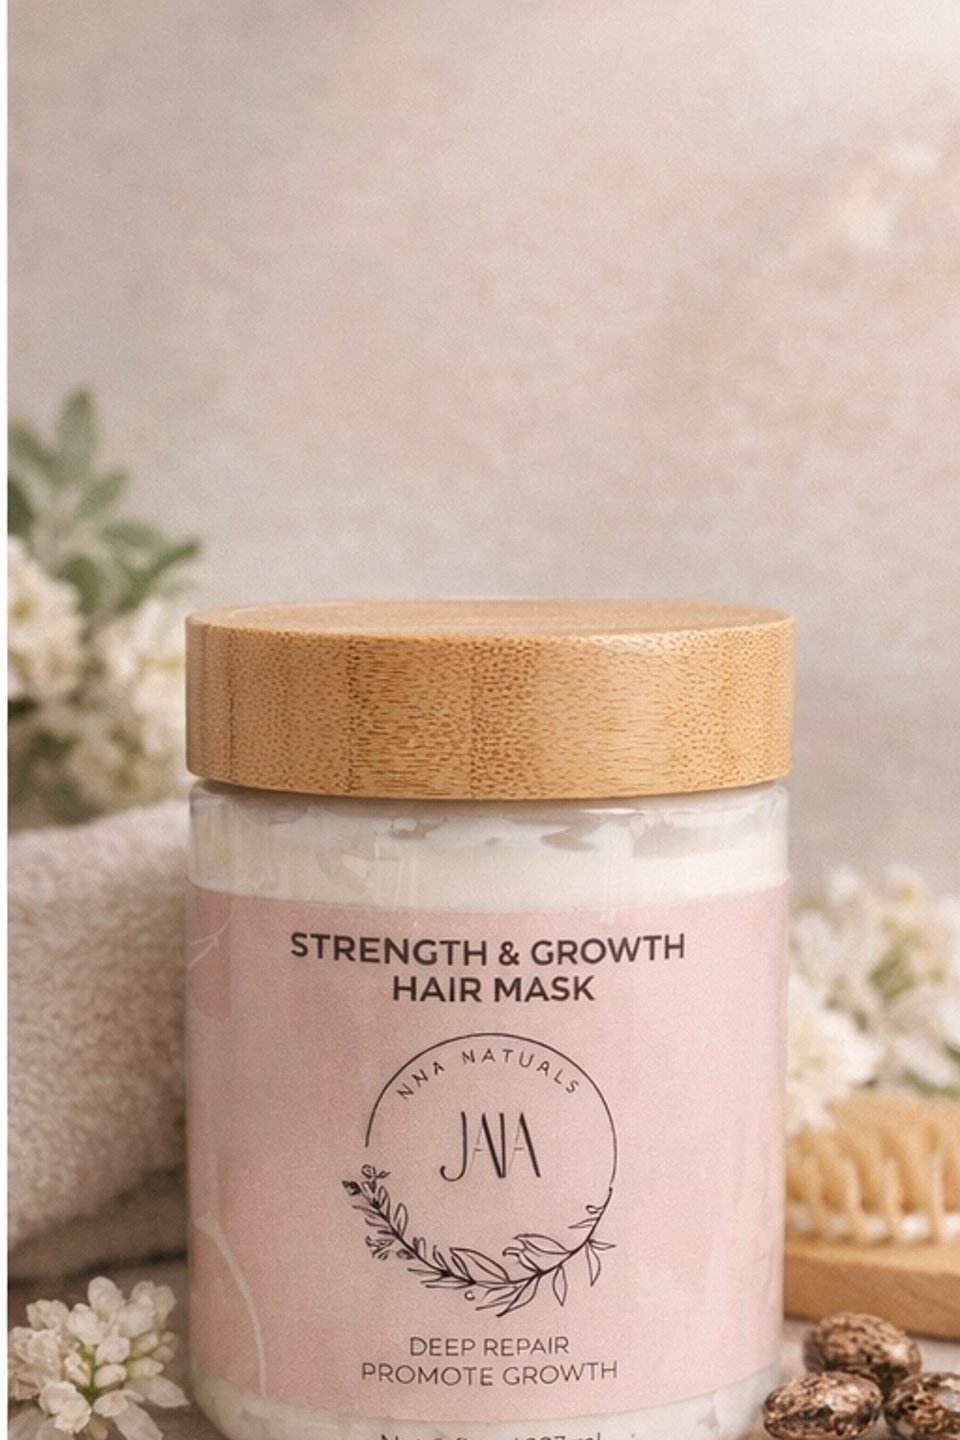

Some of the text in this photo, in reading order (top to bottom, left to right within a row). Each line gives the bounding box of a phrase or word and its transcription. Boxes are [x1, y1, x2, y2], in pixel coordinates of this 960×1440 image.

[291, 932, 684, 966] STRENGTH & GROWTH
[393, 976, 595, 1002] HAIR MASK
[410, 1336, 569, 1357] DEEP REPAIR
[362, 1360, 617, 1386] PROMOTE GROWTH
